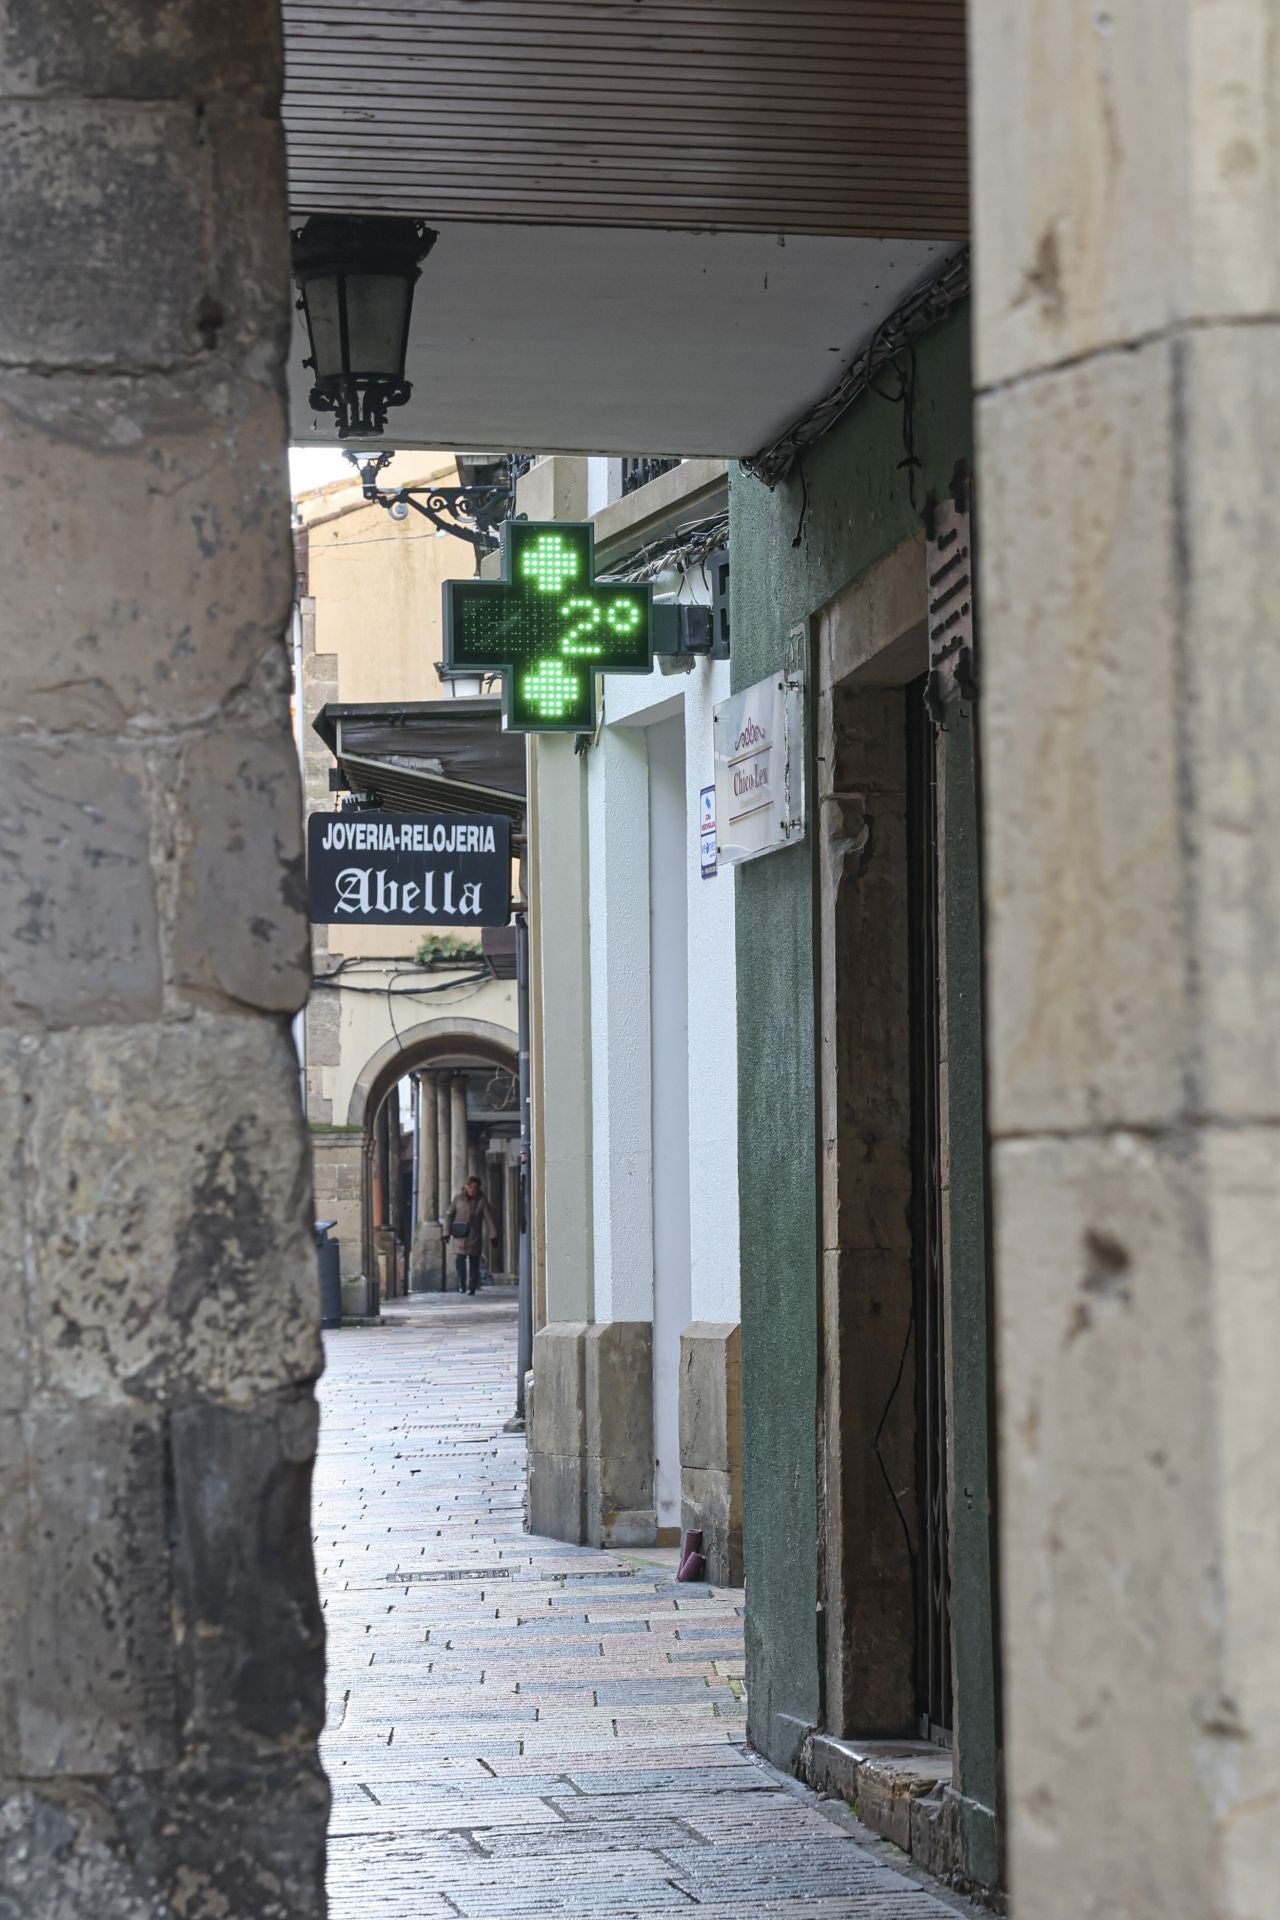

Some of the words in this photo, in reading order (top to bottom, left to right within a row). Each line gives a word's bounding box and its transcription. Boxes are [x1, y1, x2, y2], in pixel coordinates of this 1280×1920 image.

[734, 769, 753, 796] Chico
[322, 823, 496, 852] JOYERIA-RELOJERIA
[334, 868, 483, 915] Abella
